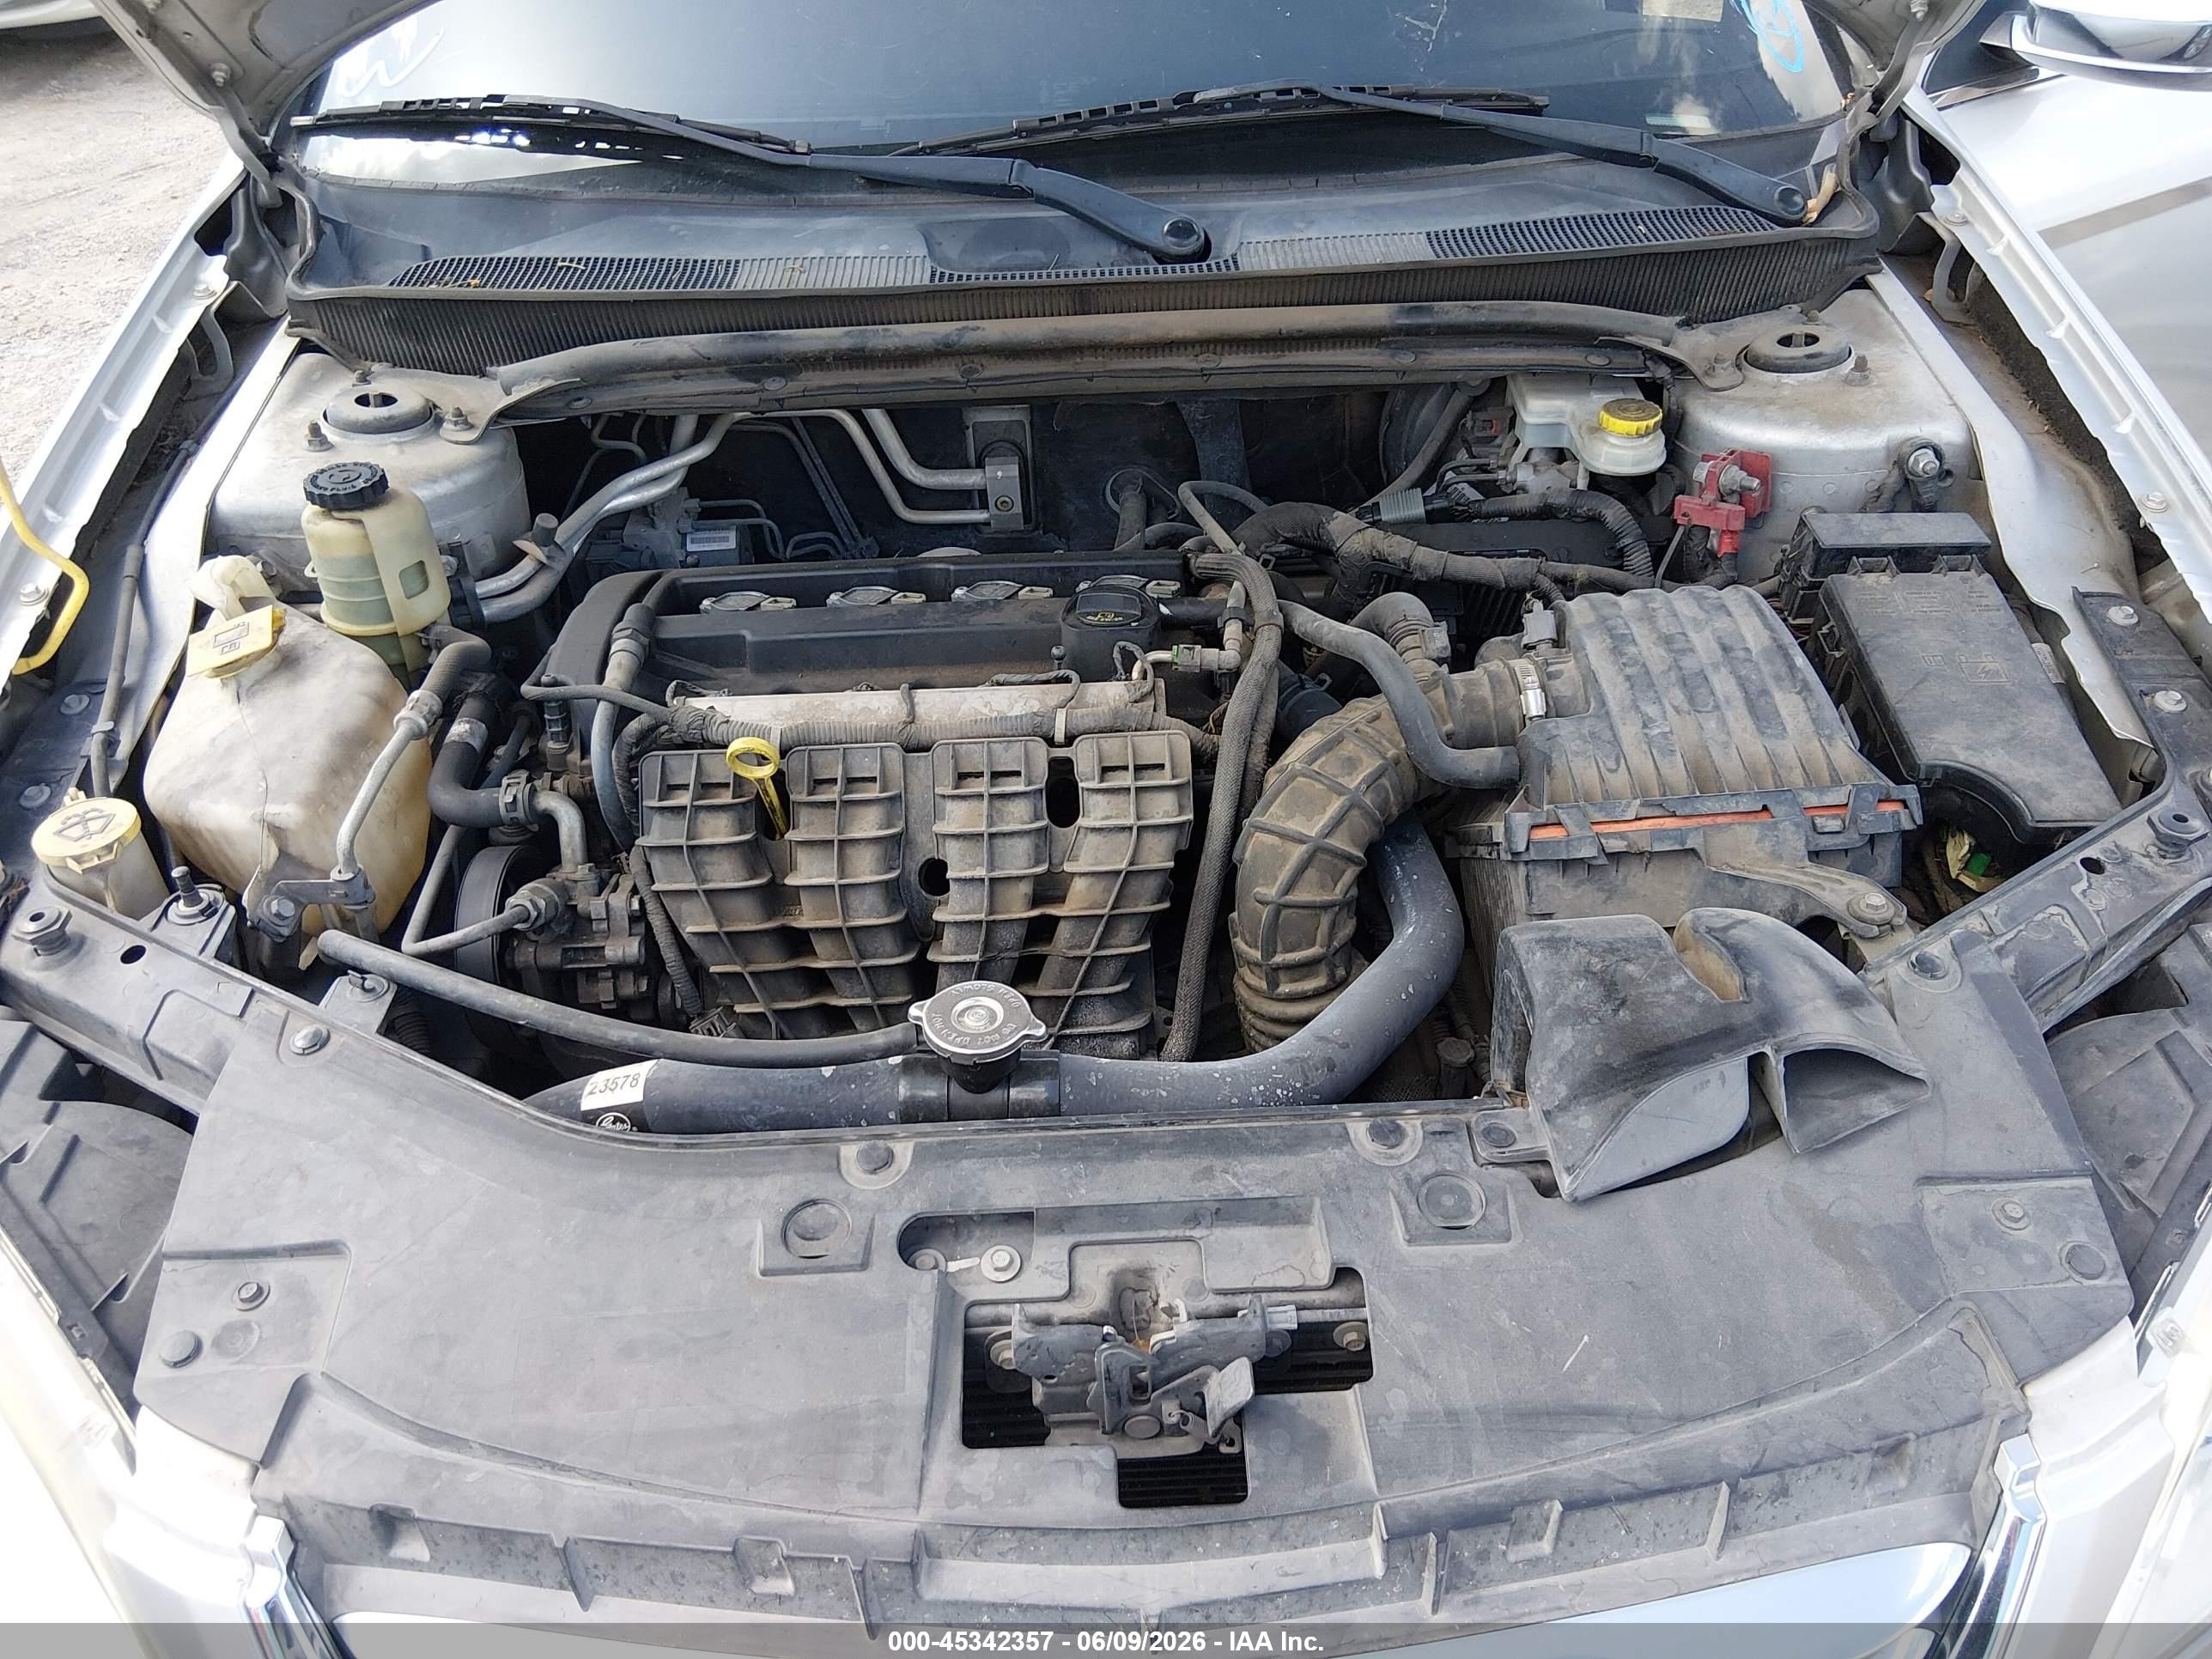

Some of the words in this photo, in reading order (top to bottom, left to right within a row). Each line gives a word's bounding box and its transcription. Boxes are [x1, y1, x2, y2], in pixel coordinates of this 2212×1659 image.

[998, 988, 1022, 1008] OPEN
[977, 1033, 1000, 1045] NOT
[586, 1072, 641, 1096] 23578
